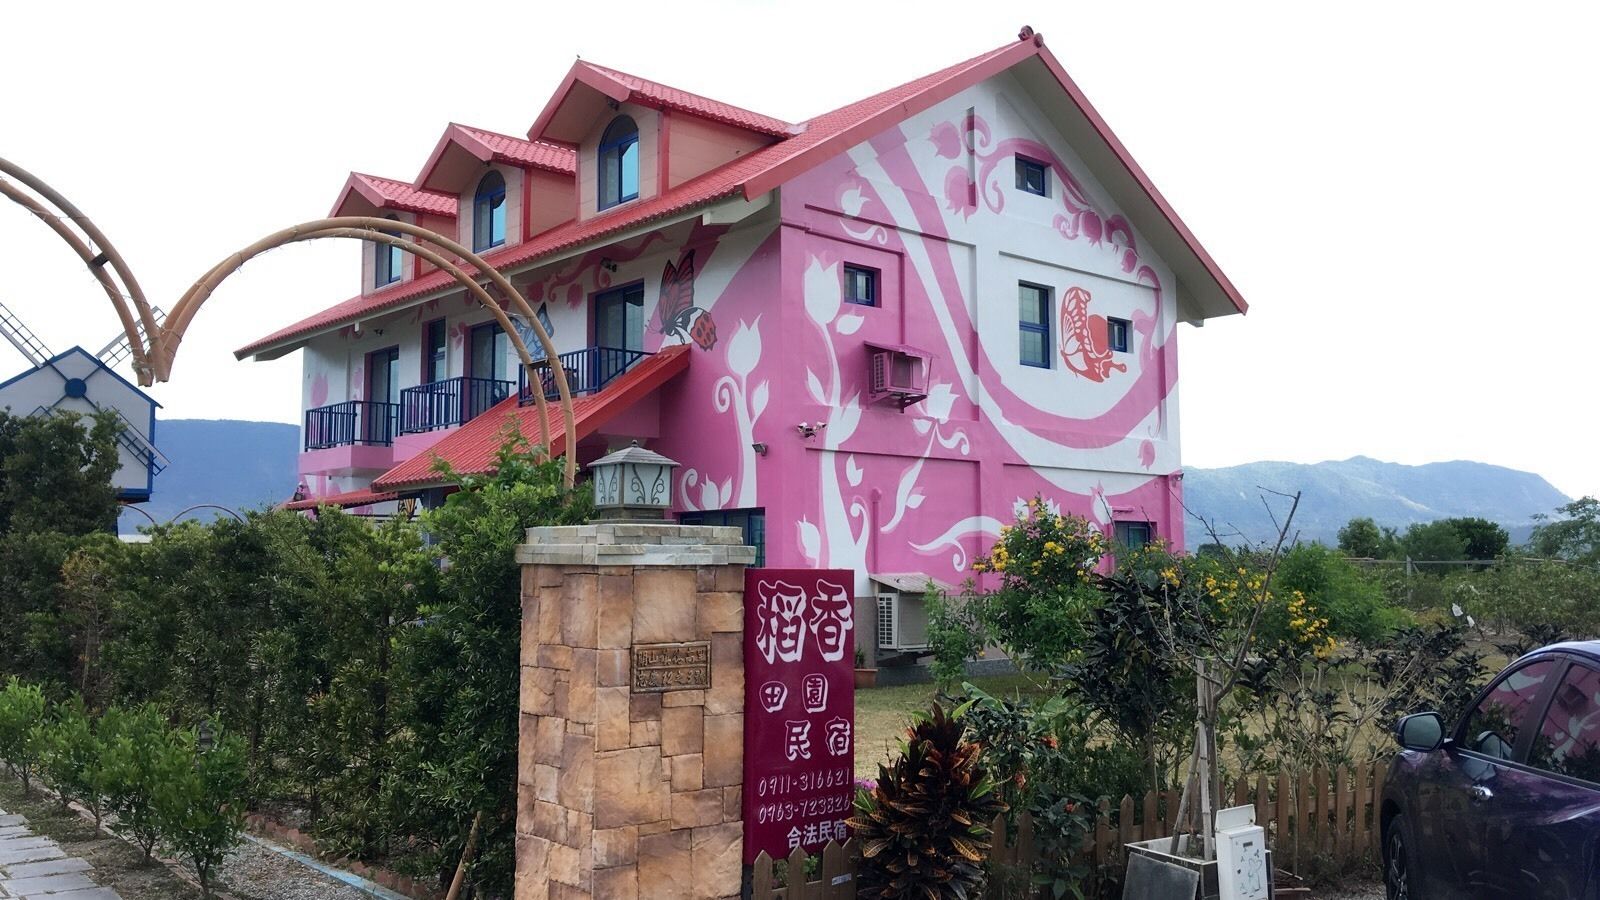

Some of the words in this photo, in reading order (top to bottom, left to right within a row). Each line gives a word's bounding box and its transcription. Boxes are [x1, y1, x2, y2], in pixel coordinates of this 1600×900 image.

[756, 579, 853, 664] 稻香
[759, 673, 828, 713] 田園
[785, 716, 850, 761] 民宿
[759, 767, 850, 797] 0911-316621
[759, 794, 850, 824] 0963-723826
[787, 819, 847, 849] 合法民宿
